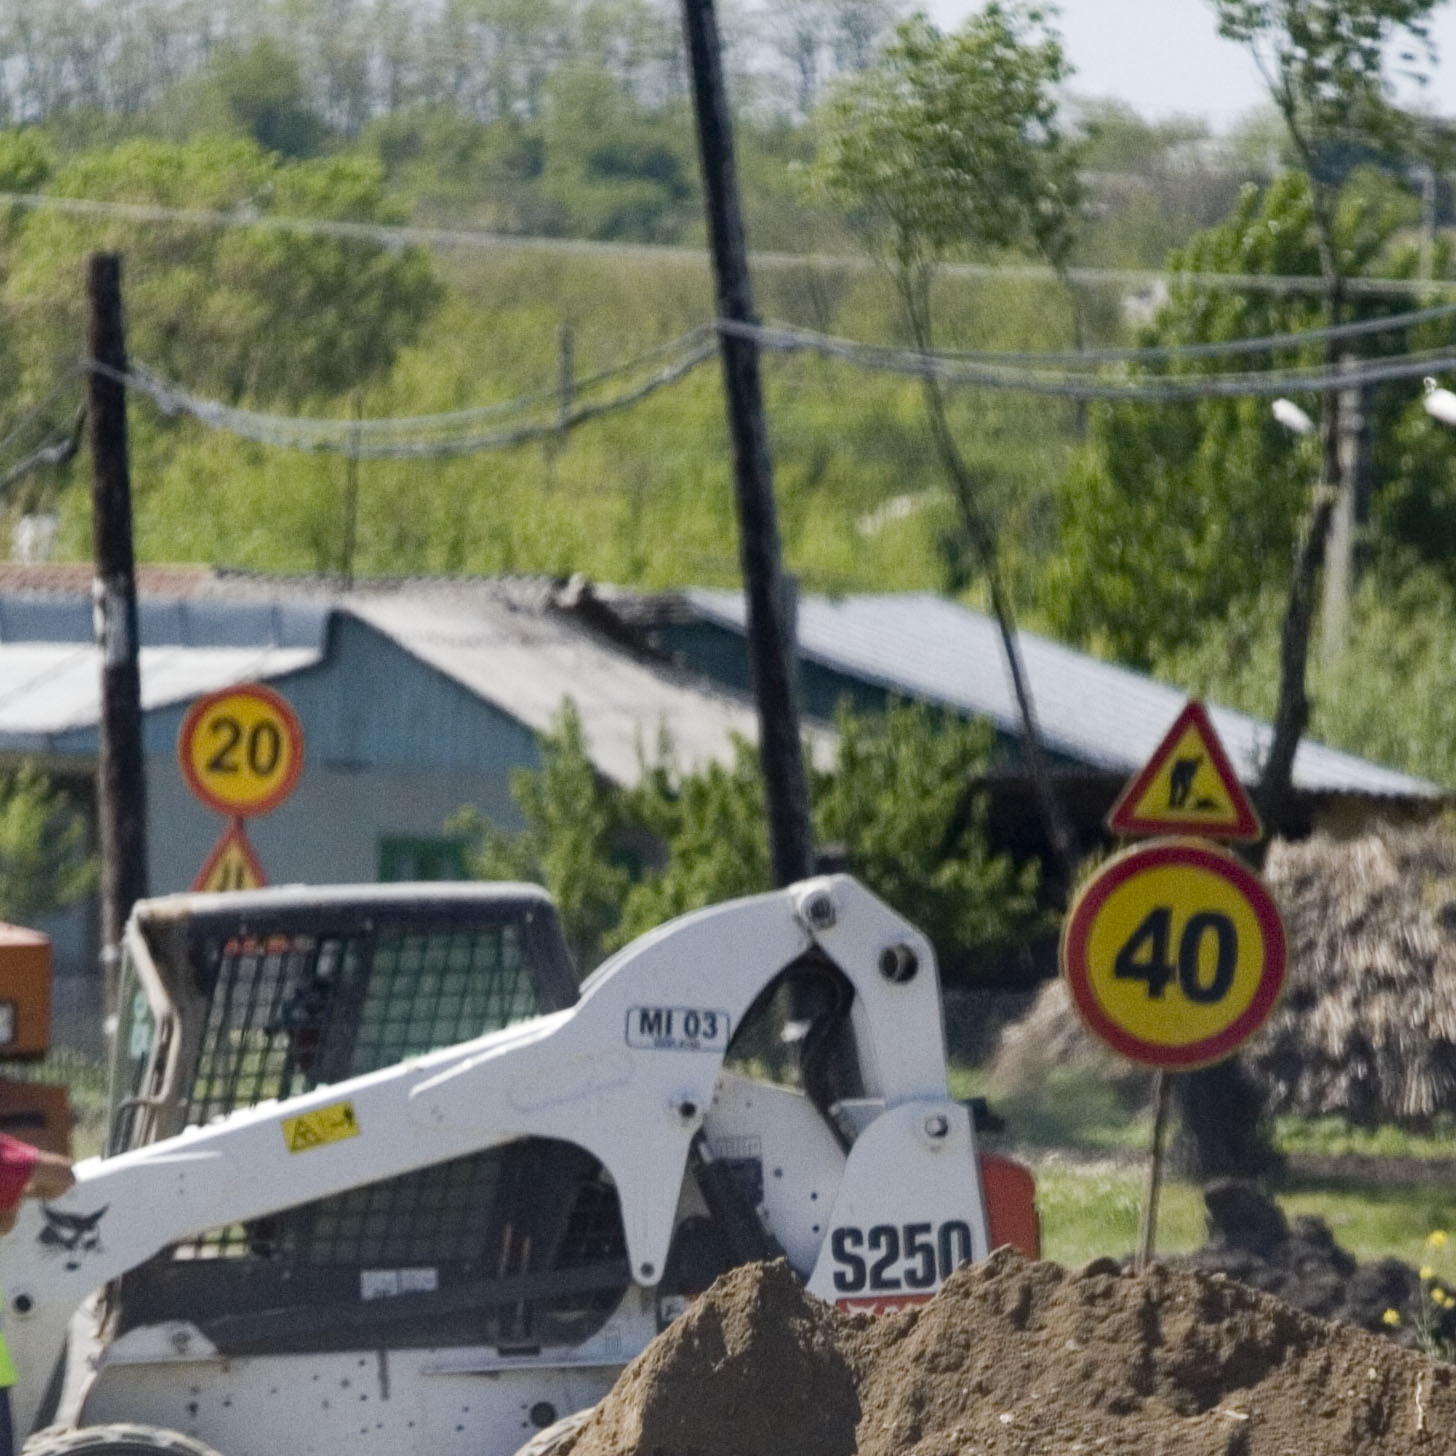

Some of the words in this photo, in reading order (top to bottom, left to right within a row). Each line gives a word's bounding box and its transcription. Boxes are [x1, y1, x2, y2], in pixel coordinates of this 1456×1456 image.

[208, 716, 281, 777] 20
[1113, 906, 1239, 1005] 40
[639, 1008, 673, 1036] MI
[683, 1009, 719, 1040] 03
[831, 1220, 973, 1293] S250
